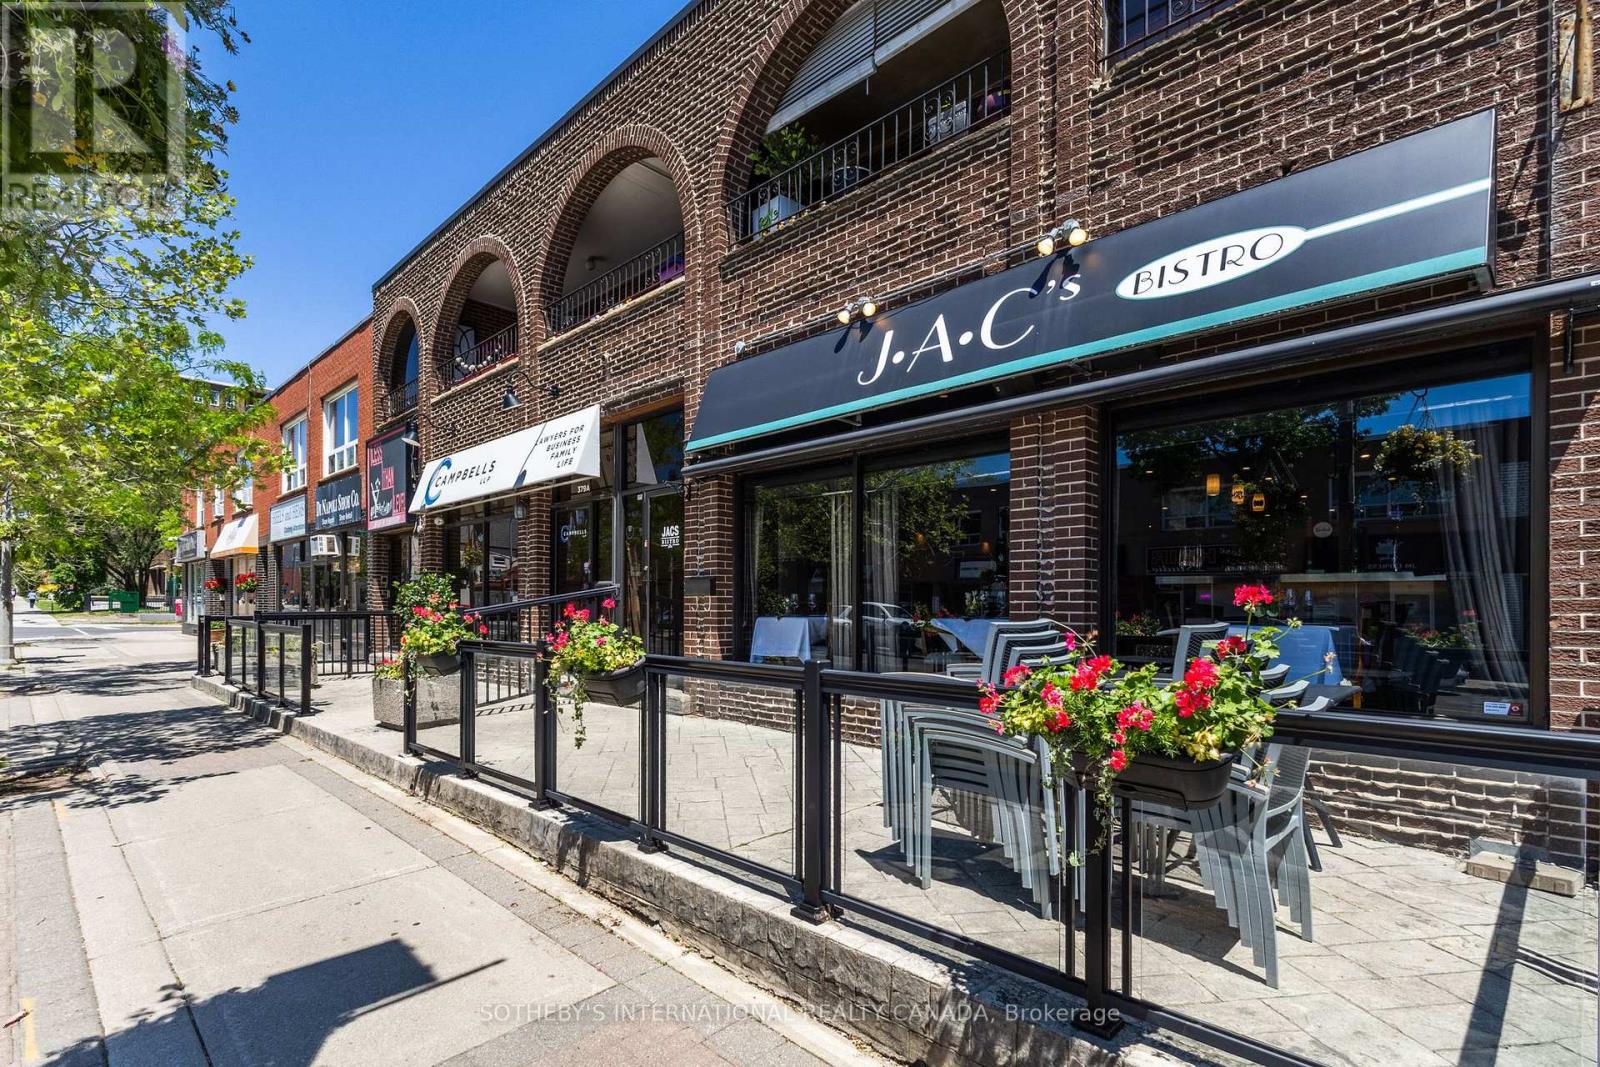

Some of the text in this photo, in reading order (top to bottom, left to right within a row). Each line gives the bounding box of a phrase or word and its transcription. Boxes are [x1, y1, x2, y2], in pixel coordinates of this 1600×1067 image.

[1132, 233, 1284, 296] BISTRO
[569, 424, 585, 435] FOR
[546, 435, 581, 452] BUSINESS
[550, 446, 578, 461] FAMILY
[557, 457, 574, 468] LIFE
[435, 460, 496, 488] CAMPBELLS
[577, 484, 591, 493] 379A
[661, 525, 680, 537] JACS
